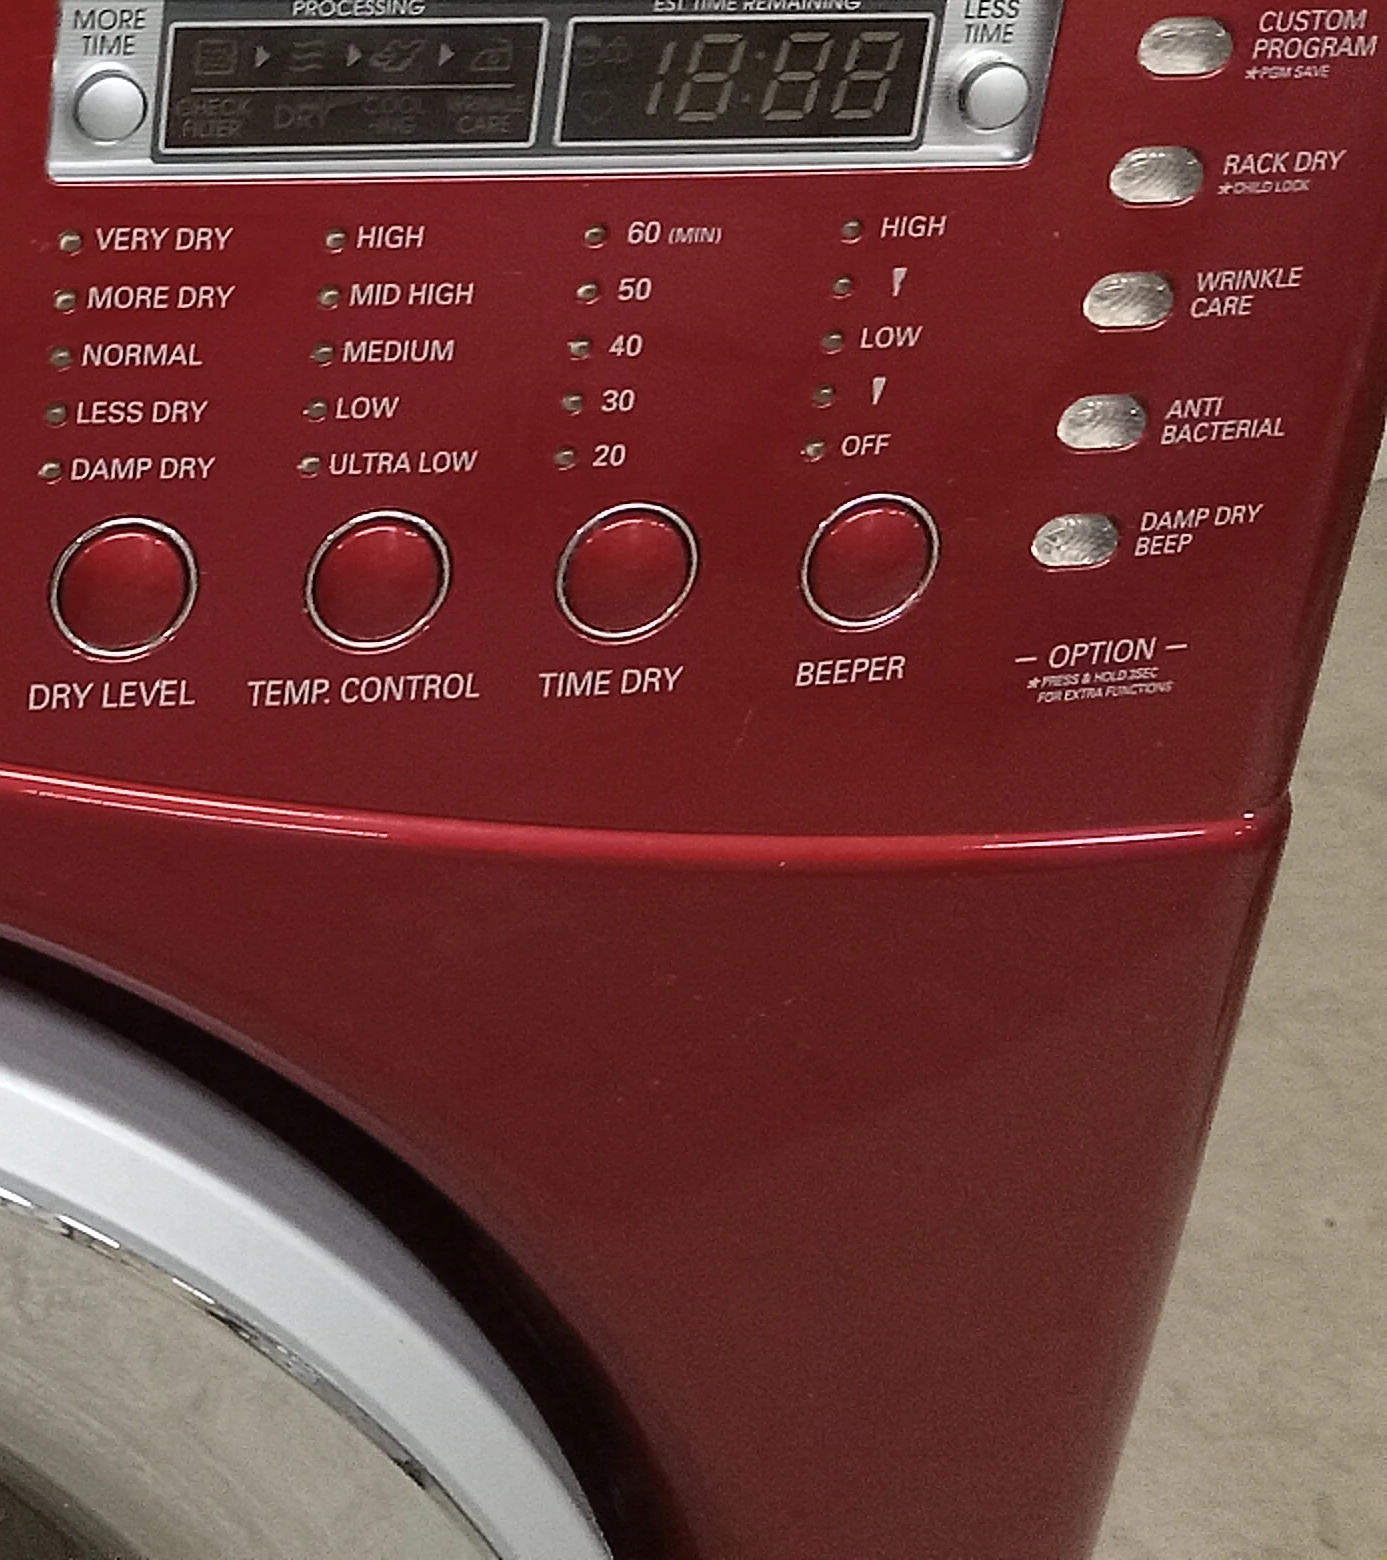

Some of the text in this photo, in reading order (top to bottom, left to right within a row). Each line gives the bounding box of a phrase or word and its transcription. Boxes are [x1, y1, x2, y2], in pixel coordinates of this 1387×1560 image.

[72, 7, 147, 32] MORE
[1258, 8, 1368, 33] CUSTOM
[963, 22, 1015, 44] TIME
[81, 34, 136, 57] TIME
[1252, 34, 1378, 60] PROGRAM
[1222, 149, 1347, 176] RACK DRY
[356, 225, 425, 249] HIGH
[627, 220, 722, 245] 60 (MIN)
[880, 215, 947, 238] HIGH
[95, 227, 234, 251] VERY DRY
[617, 277, 652, 301] 50
[1197, 265, 1304, 293] WRINKLE
[87, 285, 236, 309] MORE DRY
[349, 282, 474, 306] MID HIGH
[1190, 294, 1254, 319] CARE
[608, 333, 643, 357] 40
[860, 325, 923, 349] LOW
[81, 343, 203, 367] NORMAL
[342, 339, 455, 363] MEDIUM
[76, 400, 208, 424] LESS DRY
[335, 396, 400, 420] LOW
[601, 389, 635, 412] 30
[1164, 396, 1224, 420] ANTI
[1160, 415, 1285, 445] BACTERIAL
[592, 443, 626, 467] 20
[841, 433, 891, 457] OFF
[70, 456, 216, 481] DAMP DRY
[329, 450, 478, 475] ULTRA LOW
[1140, 503, 1264, 532] DAMP DRY
[1134, 532, 1194, 557] BEEP
[1048, 636, 1159, 670] OPTION
[538, 666, 684, 698] TIME DRY
[795, 655, 906, 687] BEEPER
[1094, 668, 1128, 683] HOLD
[28, 679, 196, 711] DRY LEVEL
[340, 672, 480, 704] CONTROL
[1064, 686, 1103, 701] EXTRA
